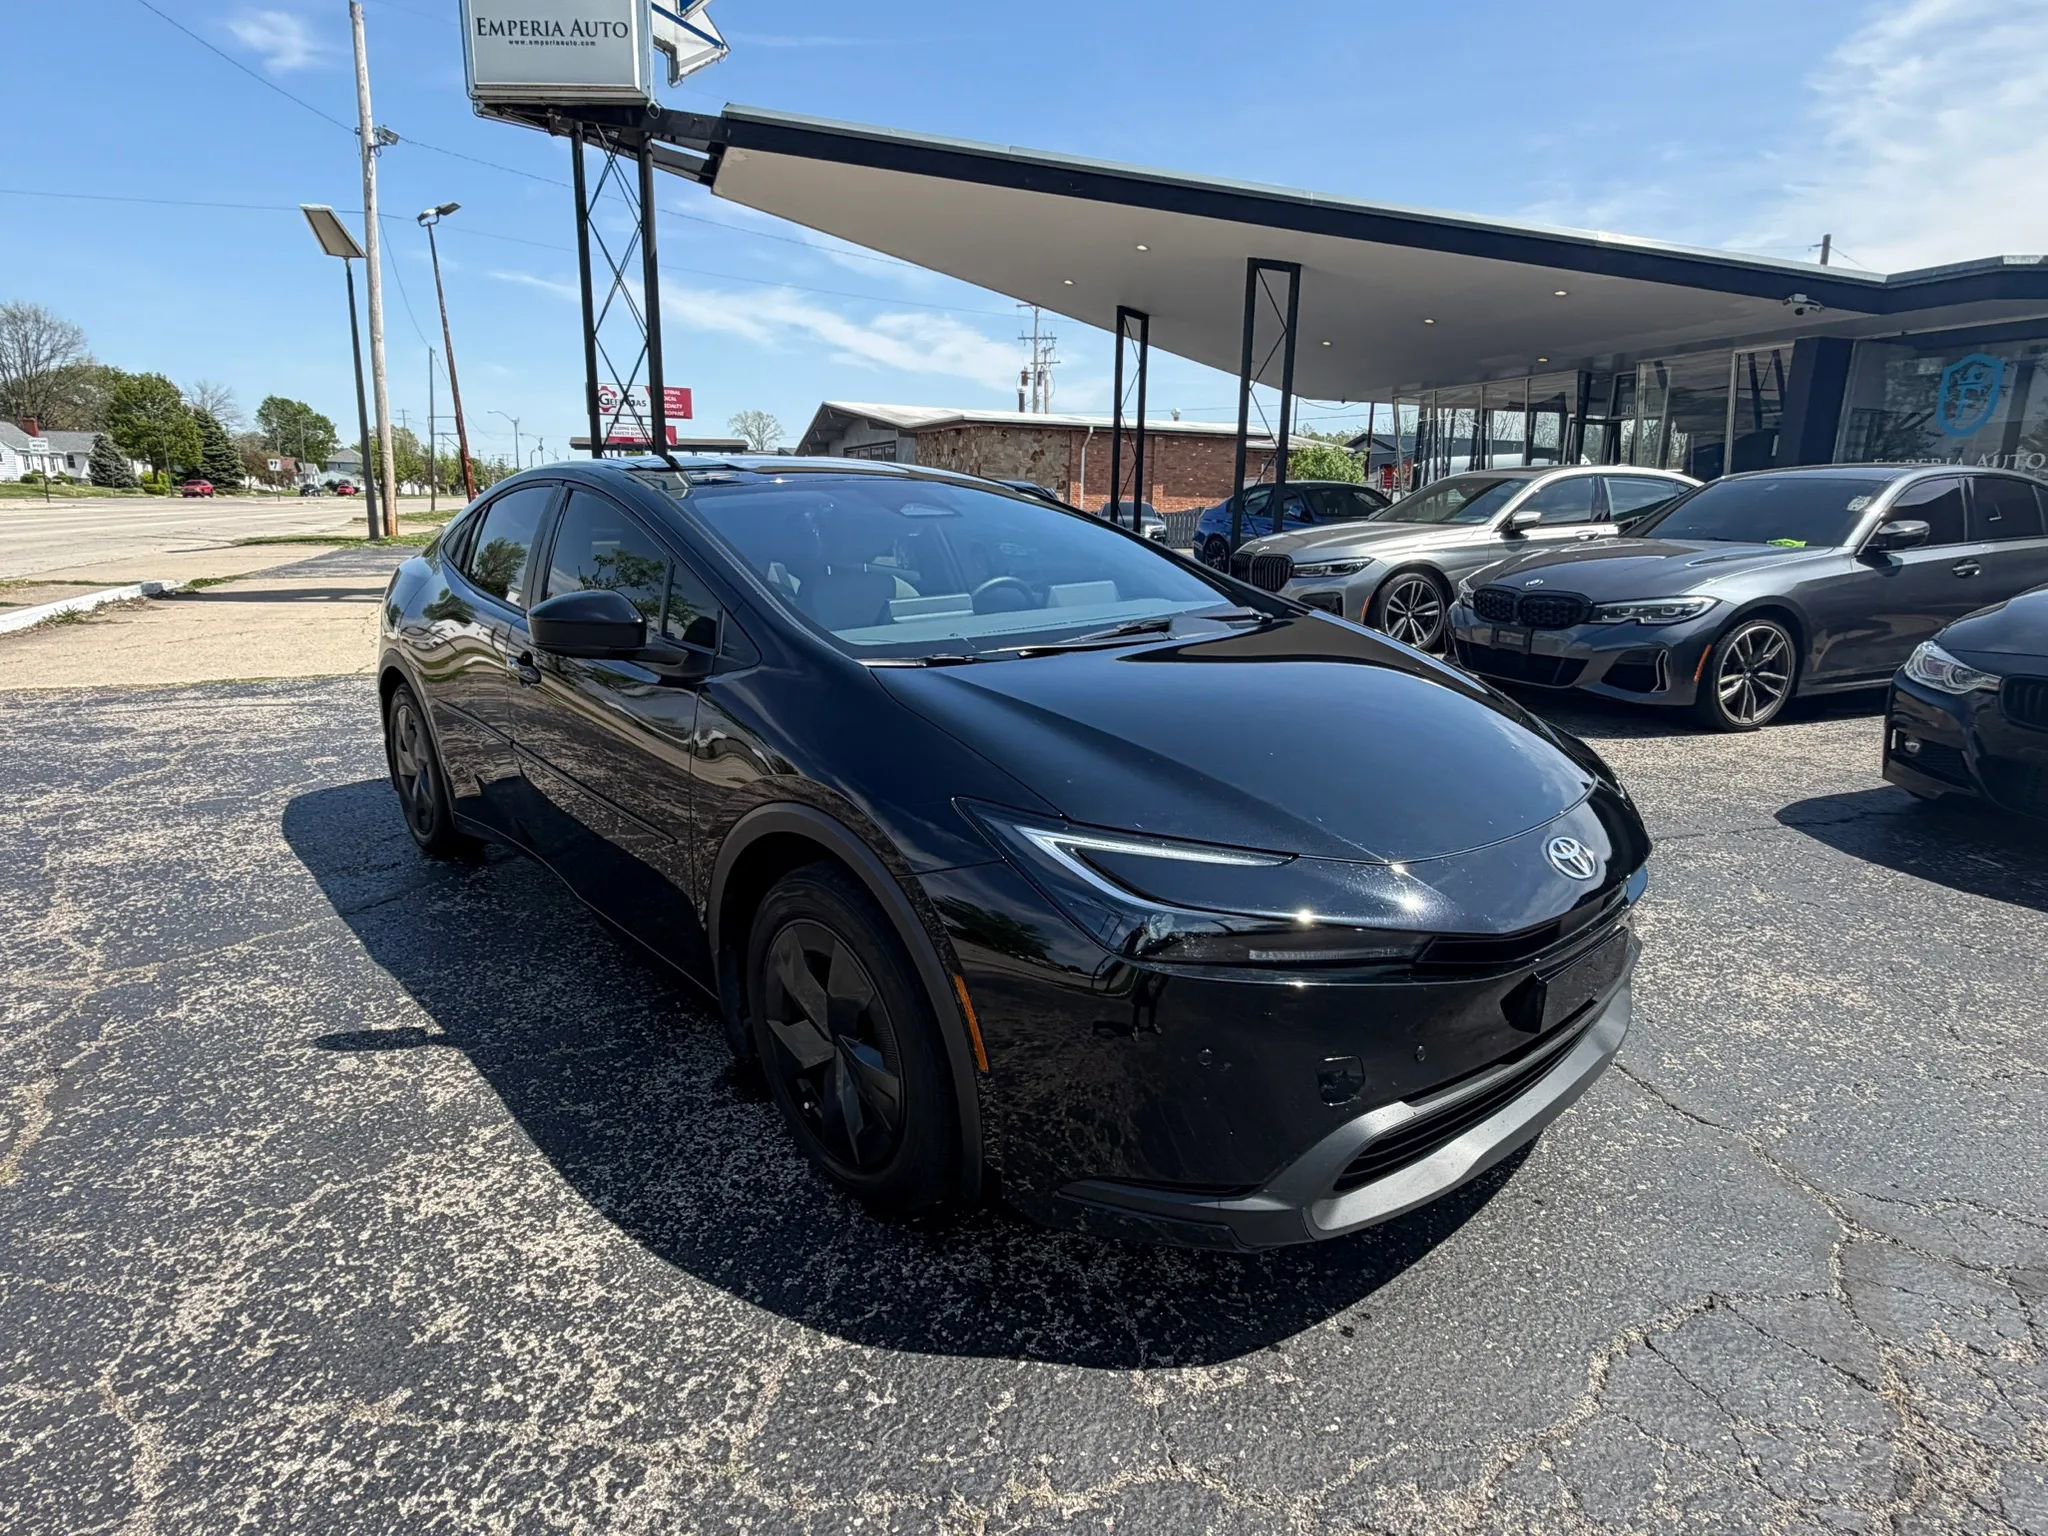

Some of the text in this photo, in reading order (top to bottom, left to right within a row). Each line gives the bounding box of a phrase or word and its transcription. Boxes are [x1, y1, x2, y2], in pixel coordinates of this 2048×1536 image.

[476, 17, 629, 39] EMPERIA AUTO
[1873, 452, 2046, 470] EPERIA AUTO
